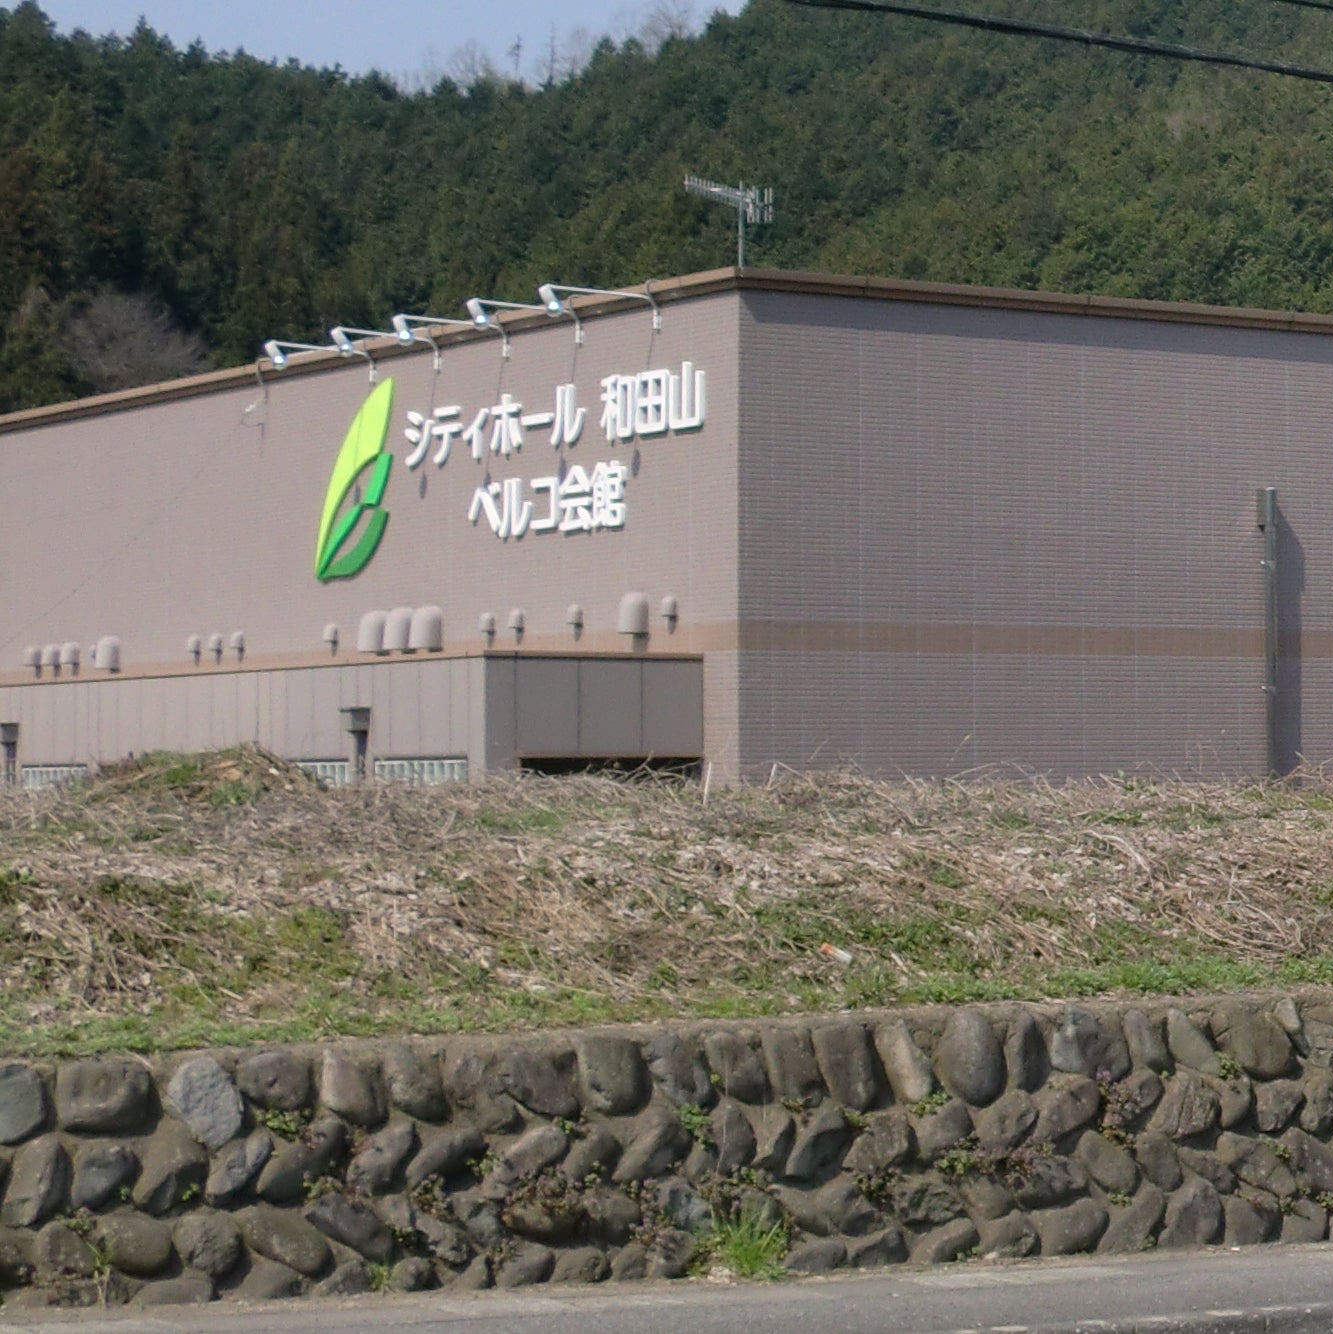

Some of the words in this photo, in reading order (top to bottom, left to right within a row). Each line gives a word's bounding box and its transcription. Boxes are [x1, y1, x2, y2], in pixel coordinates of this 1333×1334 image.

[404, 384, 587, 469] シティホール
[600, 361, 706, 442] 和田山
[467, 460, 628, 539] ベルコ会館
